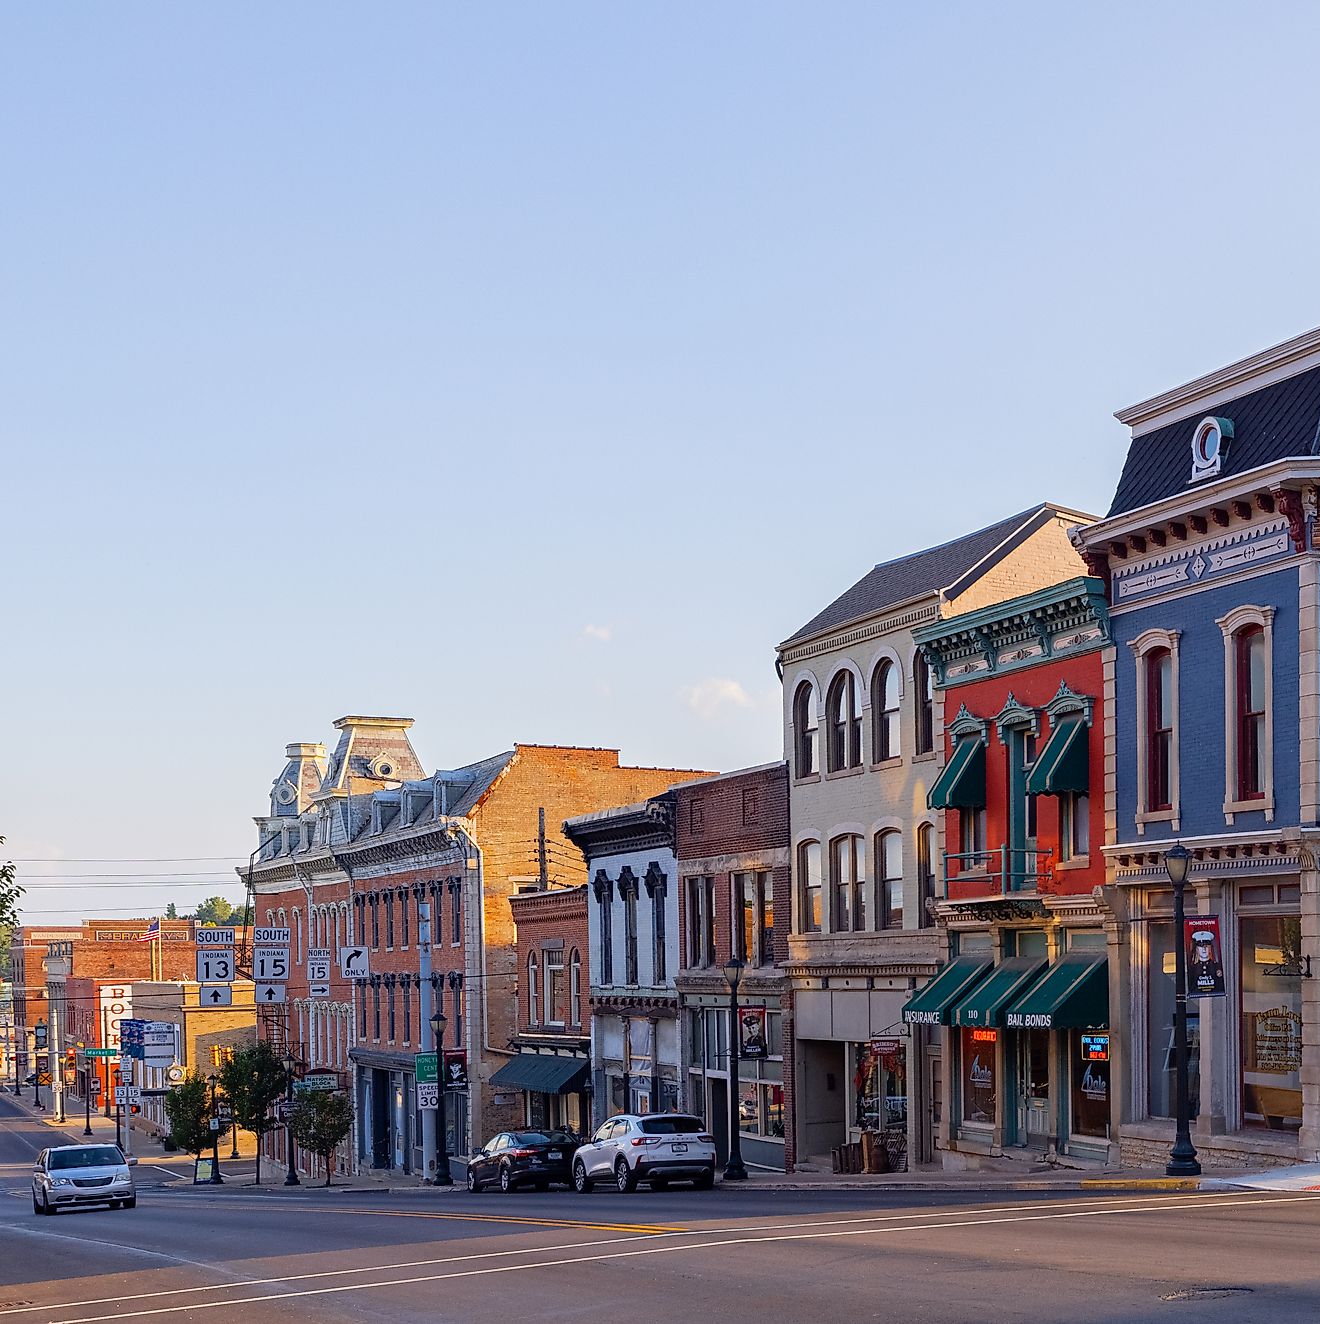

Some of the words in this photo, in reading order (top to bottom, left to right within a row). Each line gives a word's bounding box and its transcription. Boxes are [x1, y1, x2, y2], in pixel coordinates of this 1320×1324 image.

[198, 931, 233, 942] SOUTH
[256, 929, 289, 941] SOUTH
[308, 949, 331, 957] NORTH
[203, 960, 229, 979] 13
[259, 958, 286, 977] 15
[311, 966, 326, 979] 15
[344, 968, 366, 977] ONLY
[904, 1010, 940, 1024] INSURANCE
[967, 1010, 978, 1019] 110
[1007, 1013, 1024, 1027] BAIL
[1025, 1014, 1051, 1027] BONDS
[420, 1095, 438, 1107] 30
